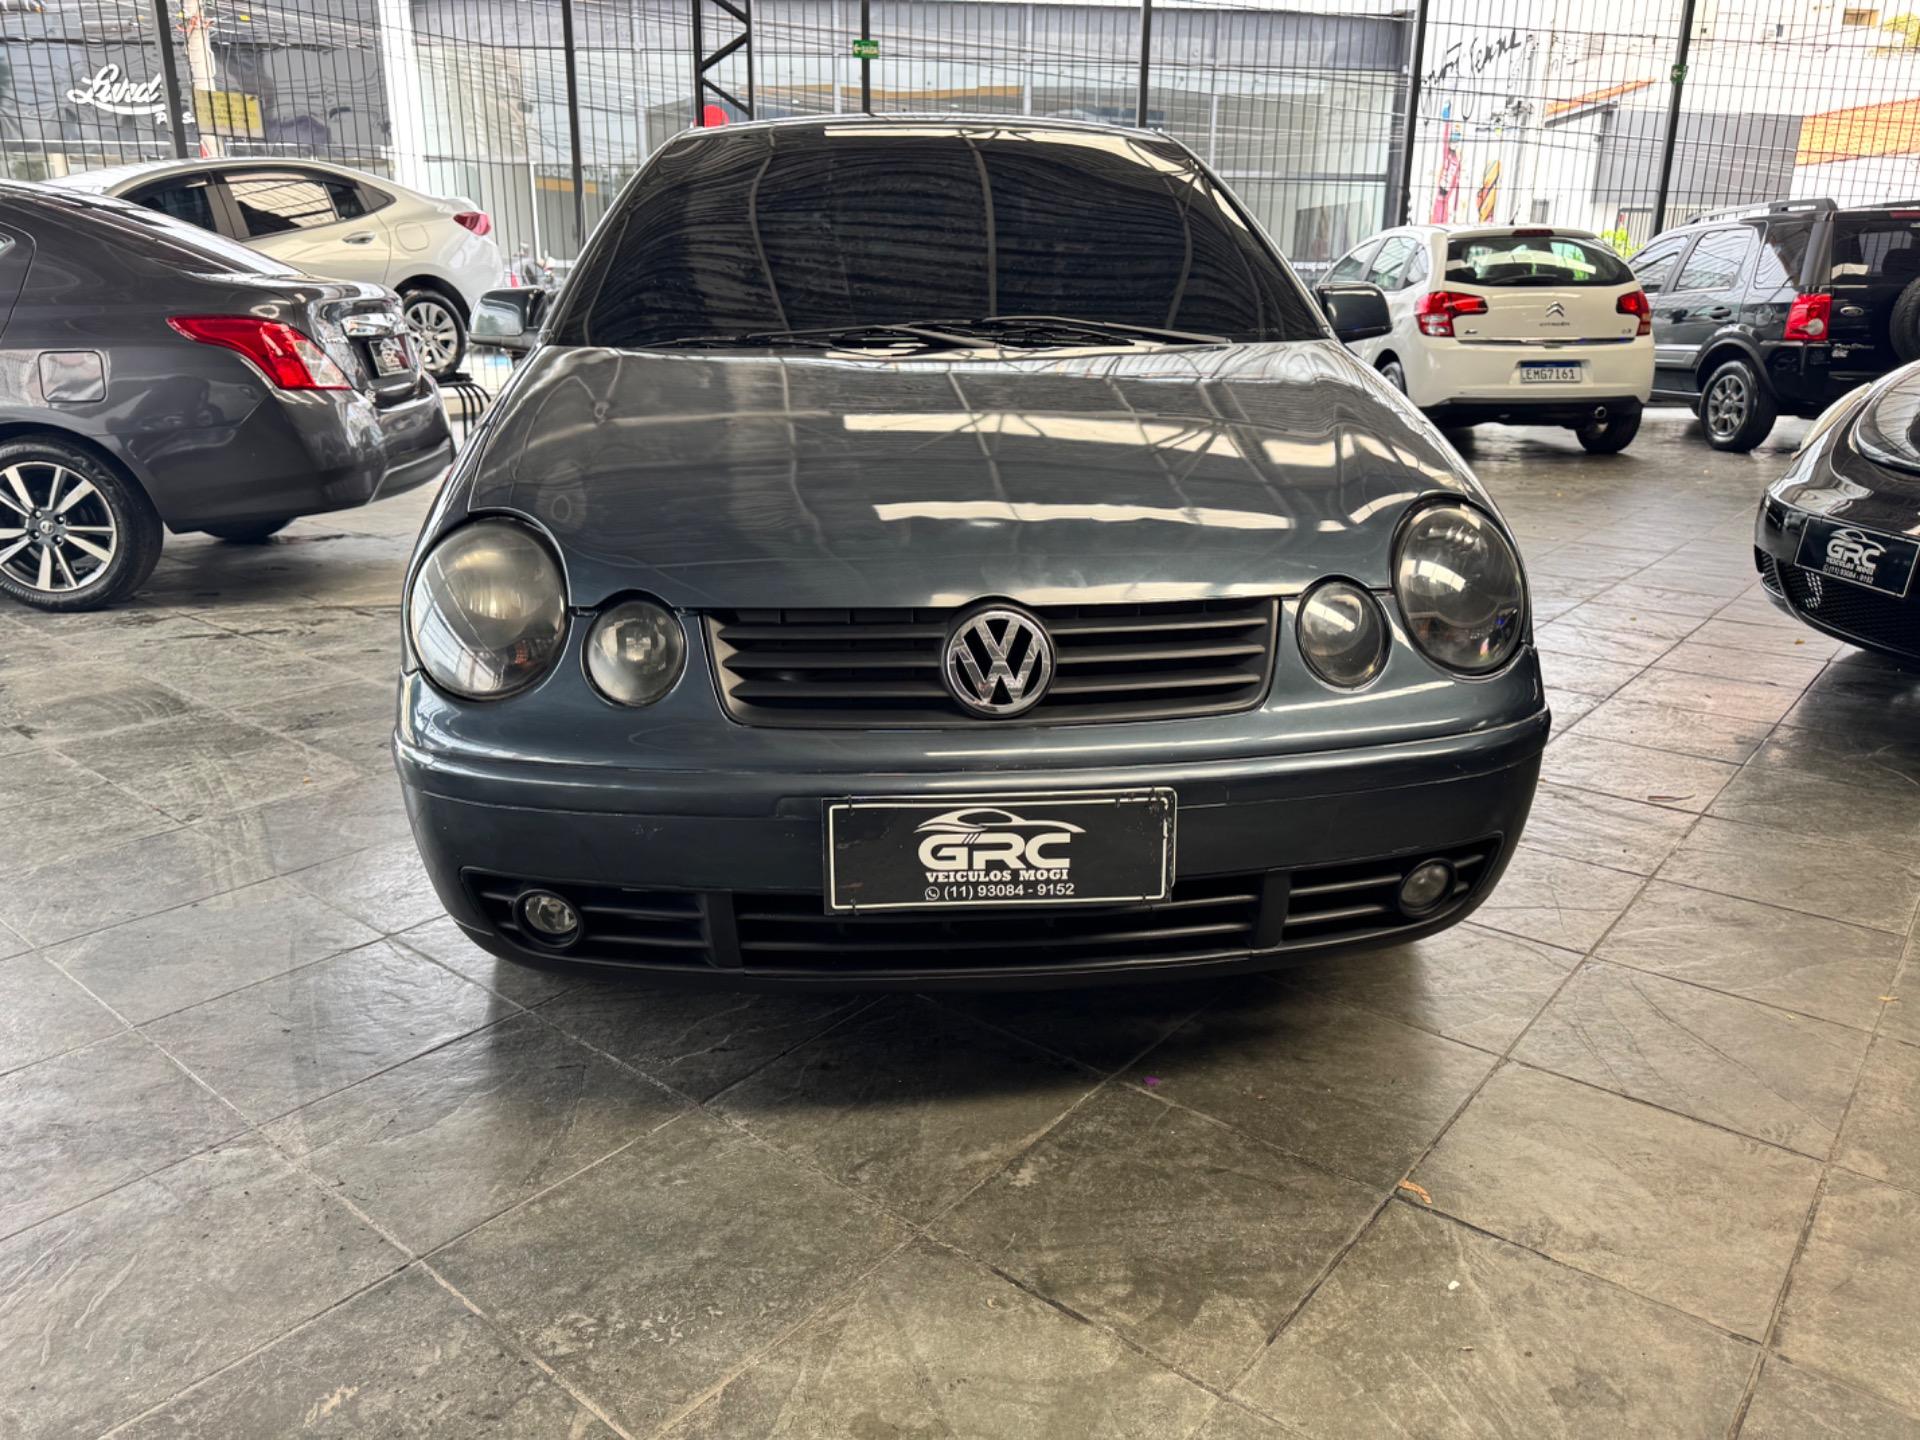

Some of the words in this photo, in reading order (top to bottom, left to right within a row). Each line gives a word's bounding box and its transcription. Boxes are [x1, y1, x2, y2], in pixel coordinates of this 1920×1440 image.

[1526, 368, 1575, 380] EMG7161
[1827, 538, 1880, 569] GRC
[918, 832, 1071, 870] GRC
[925, 870, 1011, 883] VEICULOS
[1019, 869, 1069, 881] MOGI
[944, 885, 973, 900] (11)
[977, 884, 1024, 897] 93084
[1037, 882, 1075, 896] 9152
